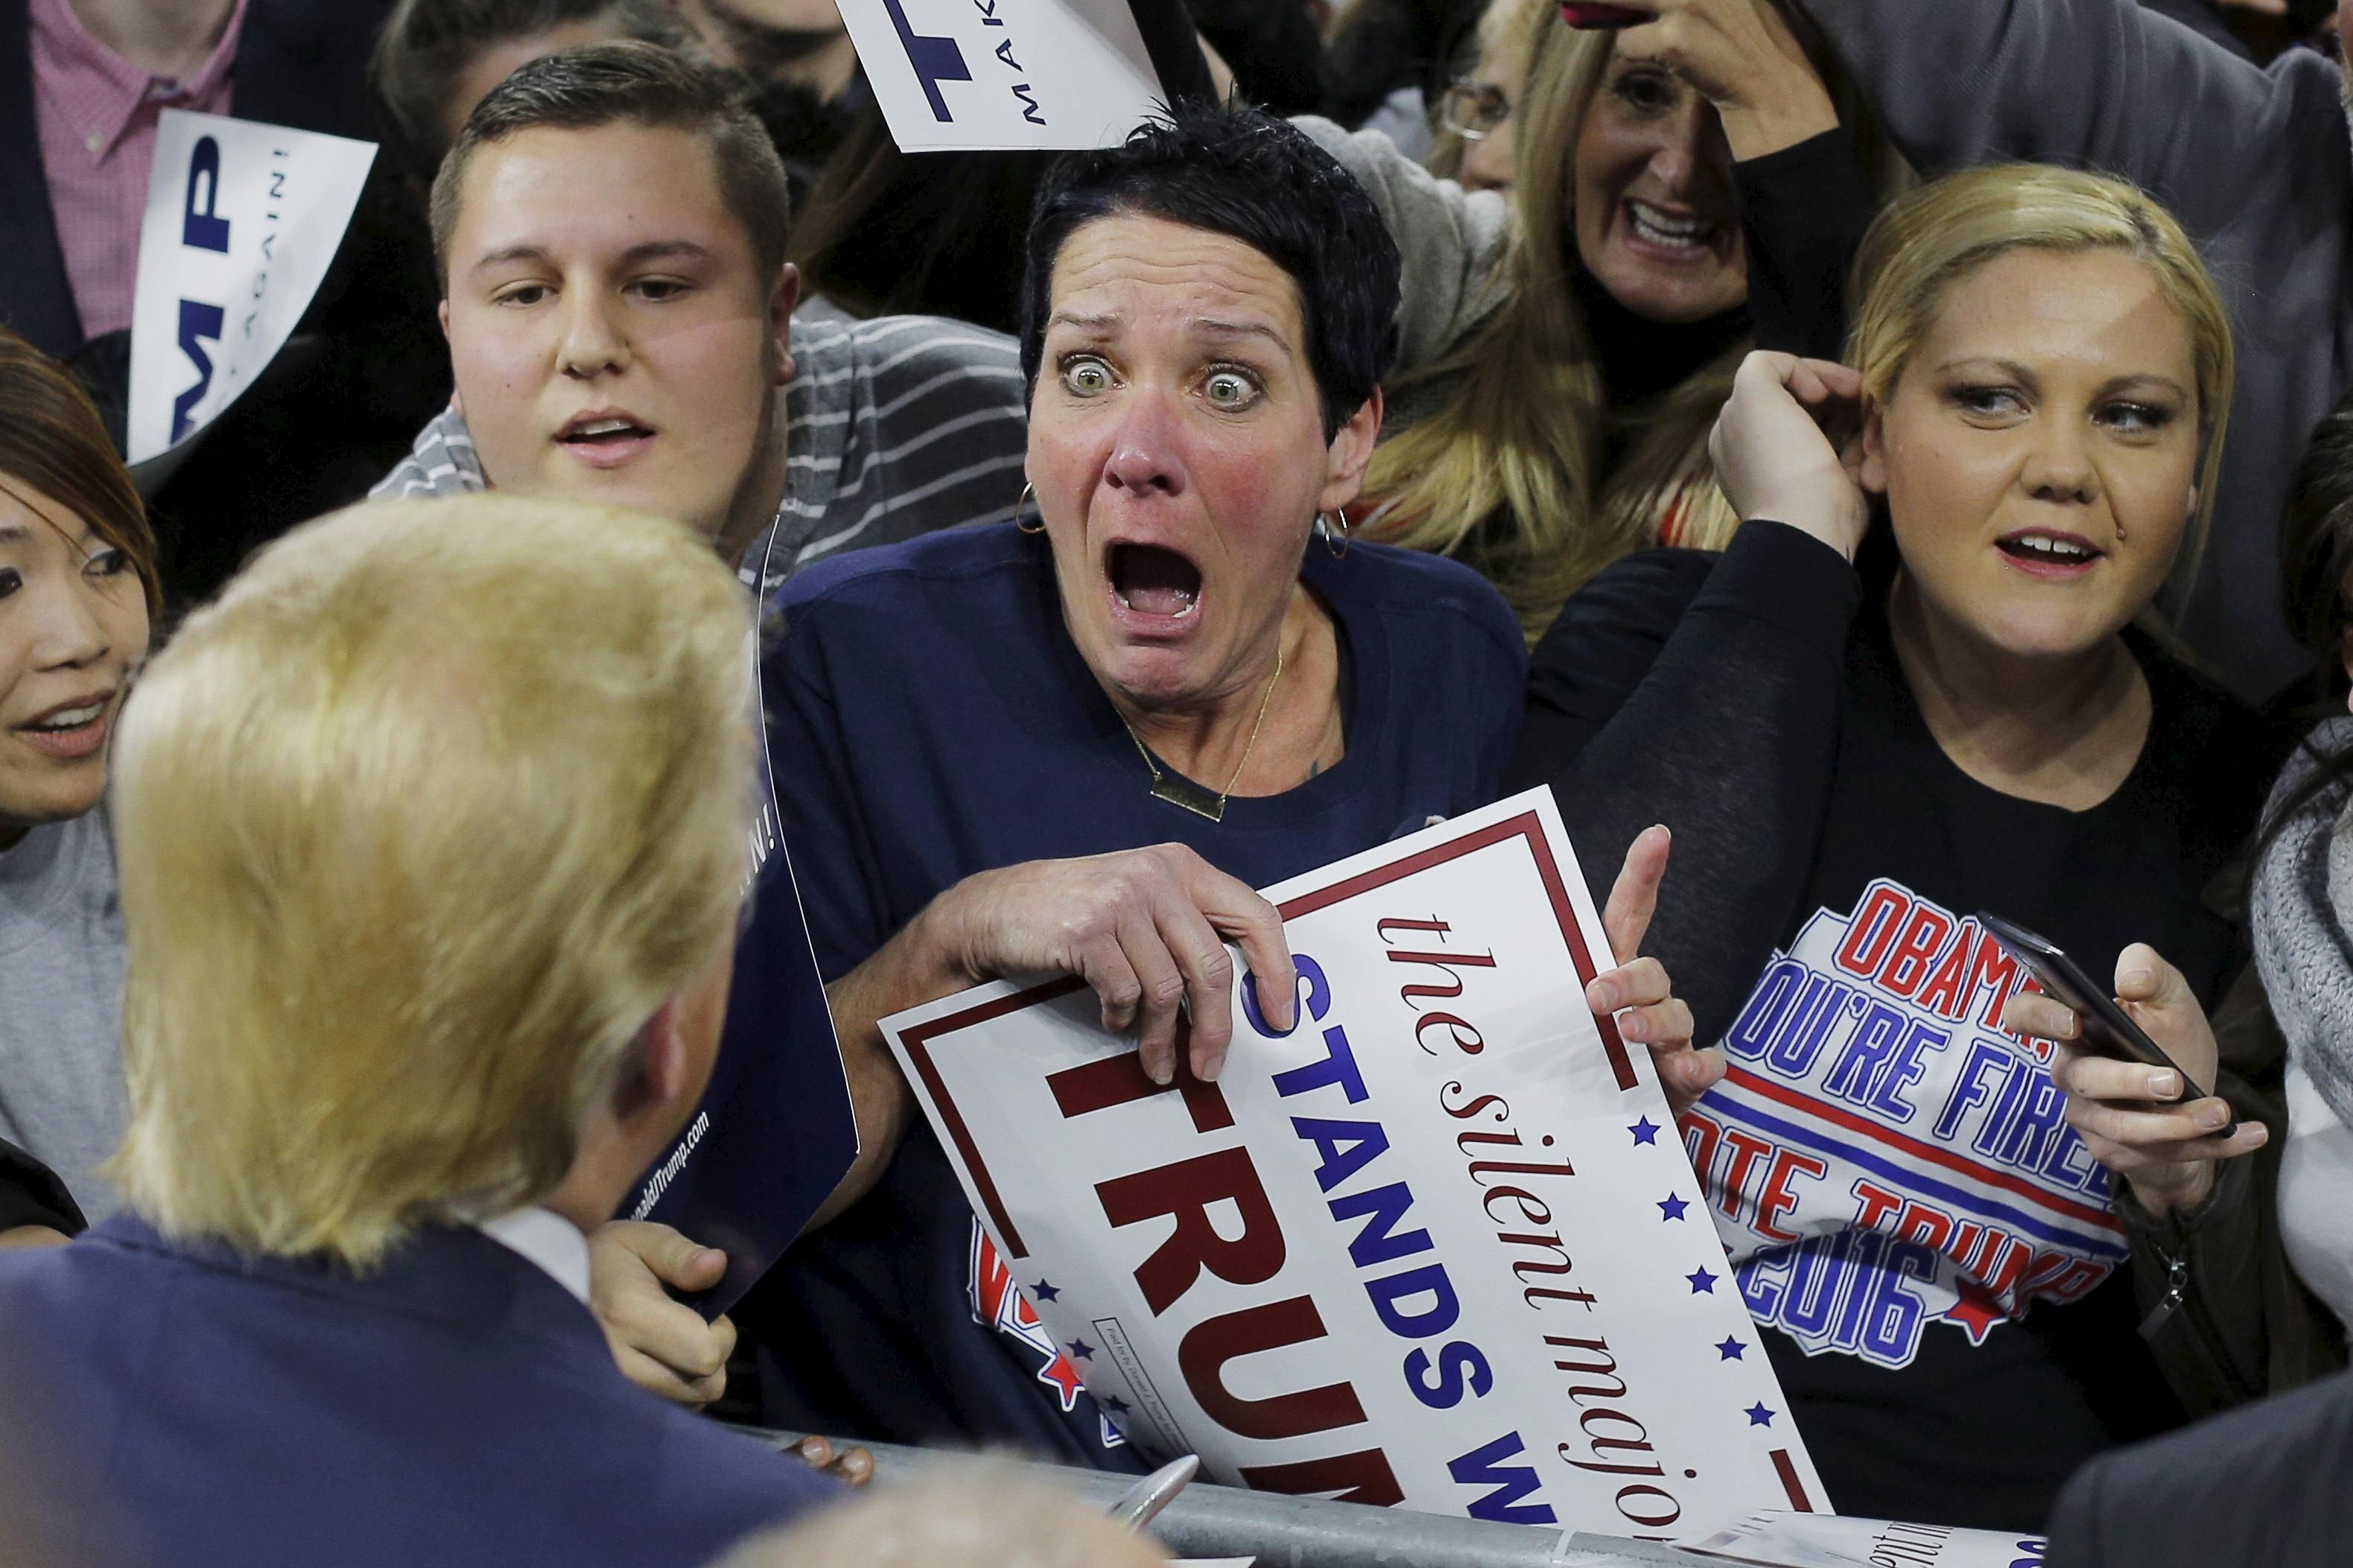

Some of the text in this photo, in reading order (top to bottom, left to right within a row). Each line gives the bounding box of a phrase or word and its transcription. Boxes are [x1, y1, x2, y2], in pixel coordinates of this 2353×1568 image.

[244, 148, 289, 338] AGAIN!
[1723, 948, 1953, 1123] OU'RE
[630, 1111, 709, 1222] naldJTrump.com
[1239, 953, 1493, 1409] STANDS
[1376, 913, 1698, 1540] the silent majo
[1678, 1110, 1826, 1242] OTE
[1733, 1228, 1939, 1365] 2016
